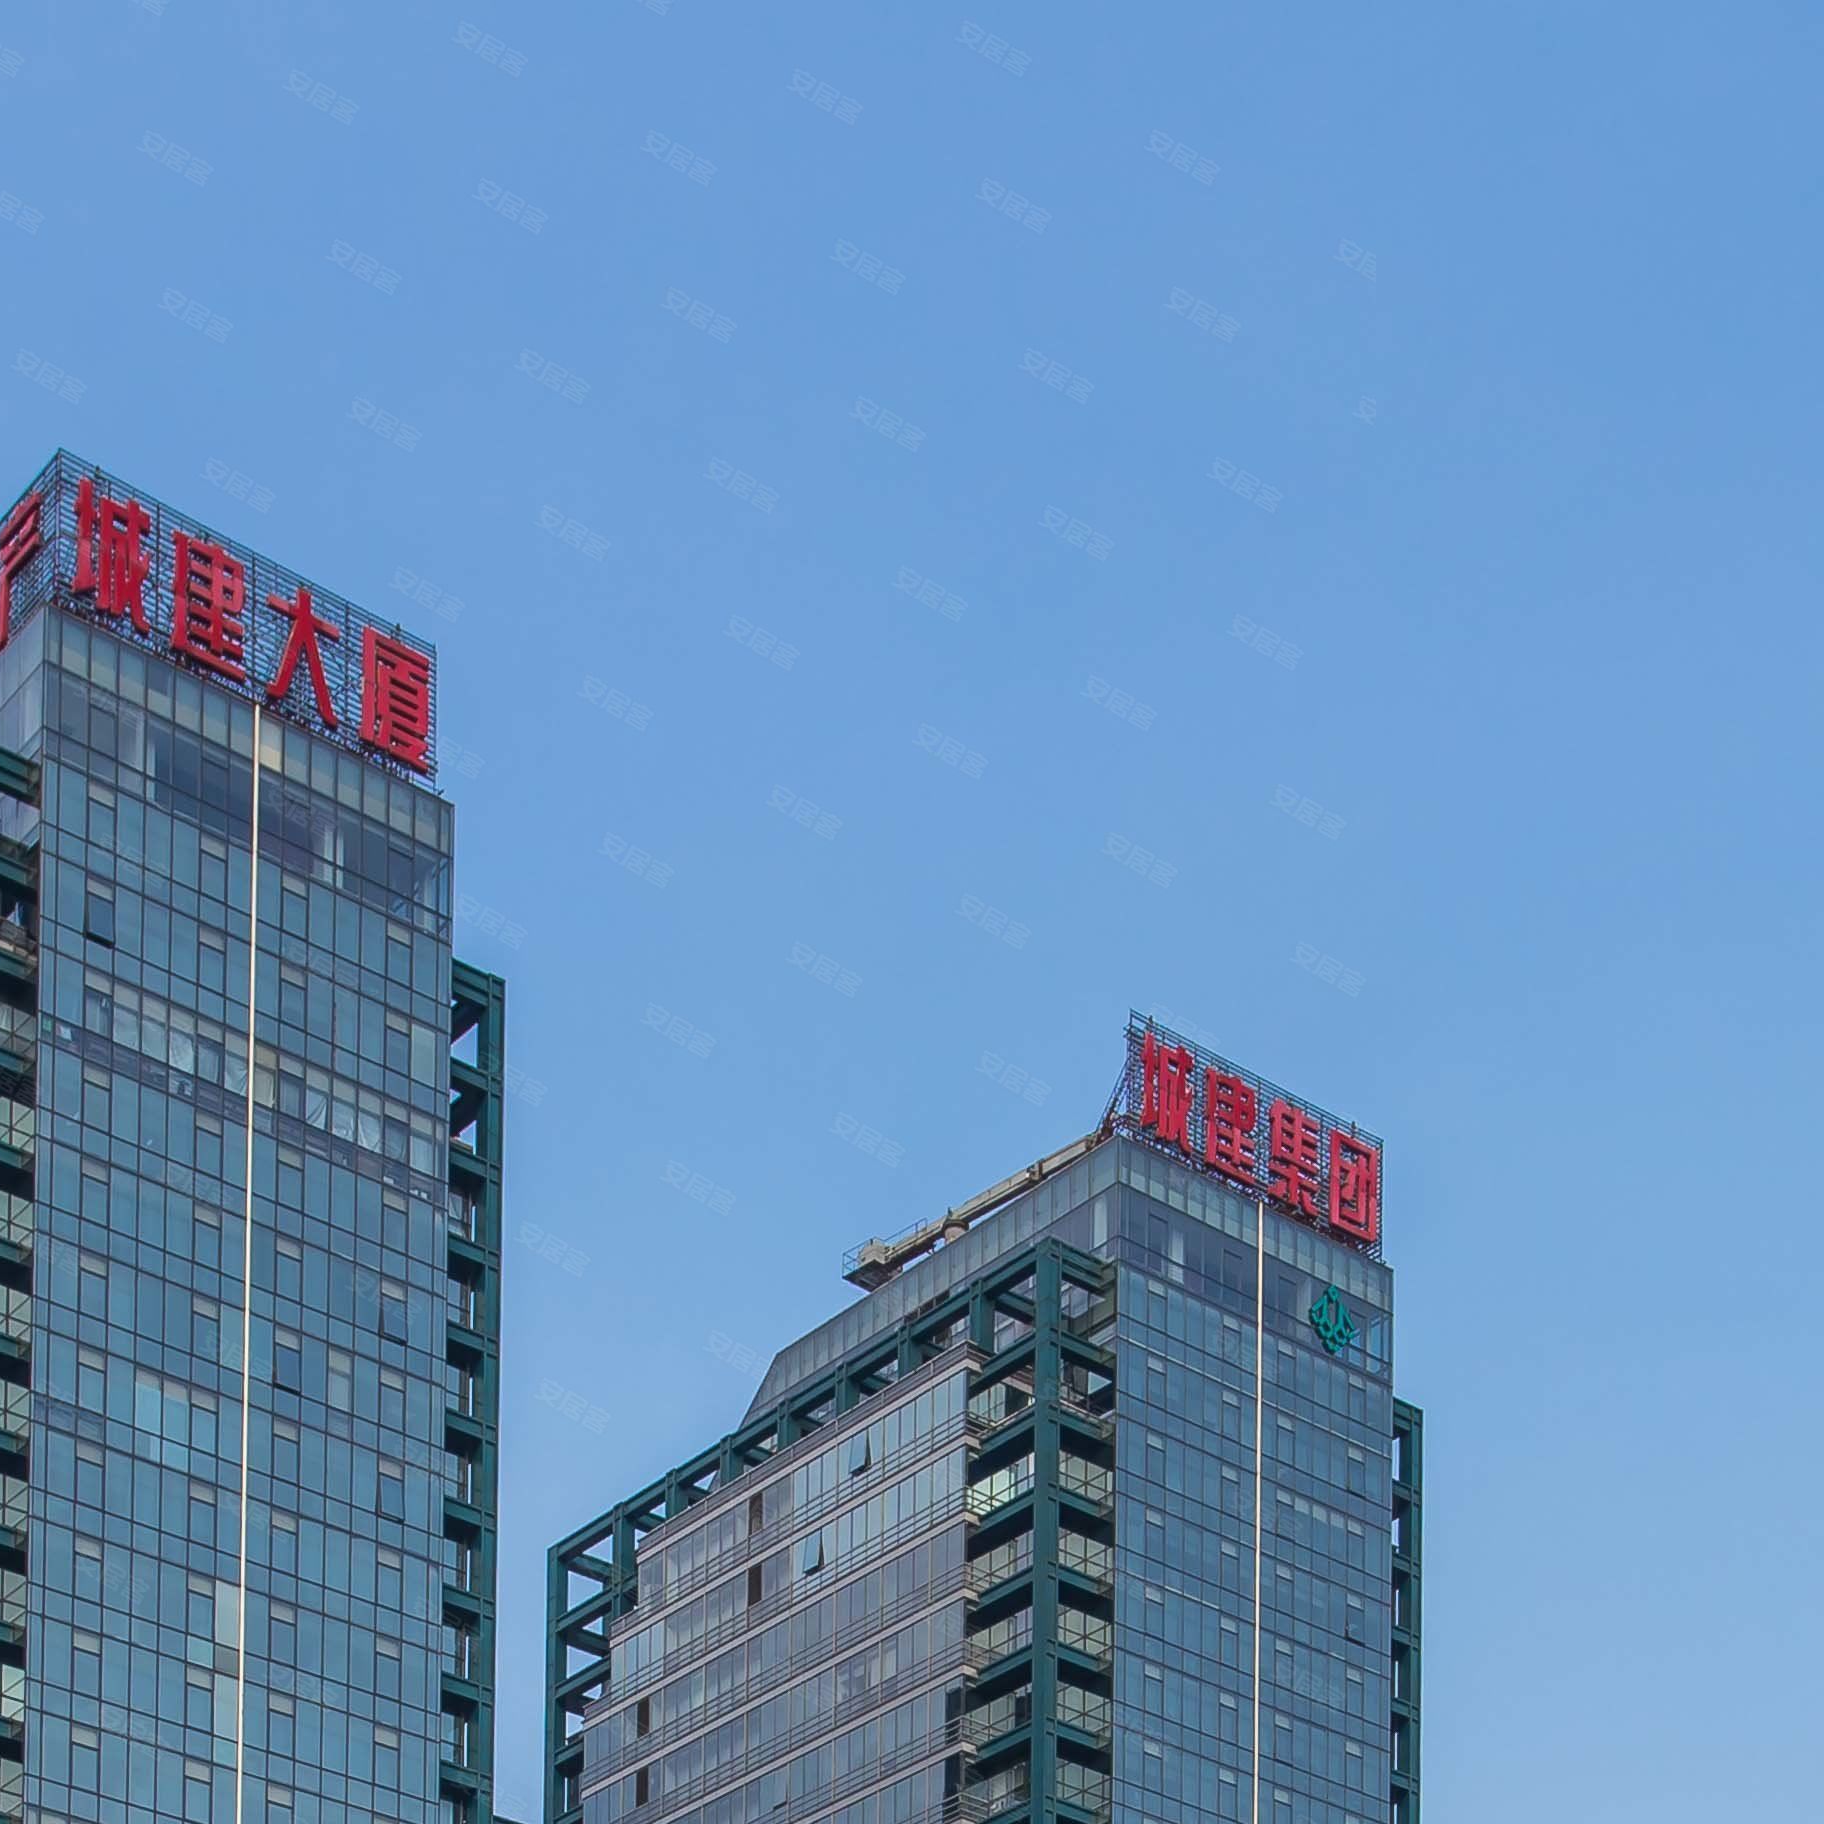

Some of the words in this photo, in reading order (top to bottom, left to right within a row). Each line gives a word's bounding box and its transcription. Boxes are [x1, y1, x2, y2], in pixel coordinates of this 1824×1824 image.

[73, 476, 430, 773] 城建大厦
[1141, 1033, 1378, 1243] 城建集团
